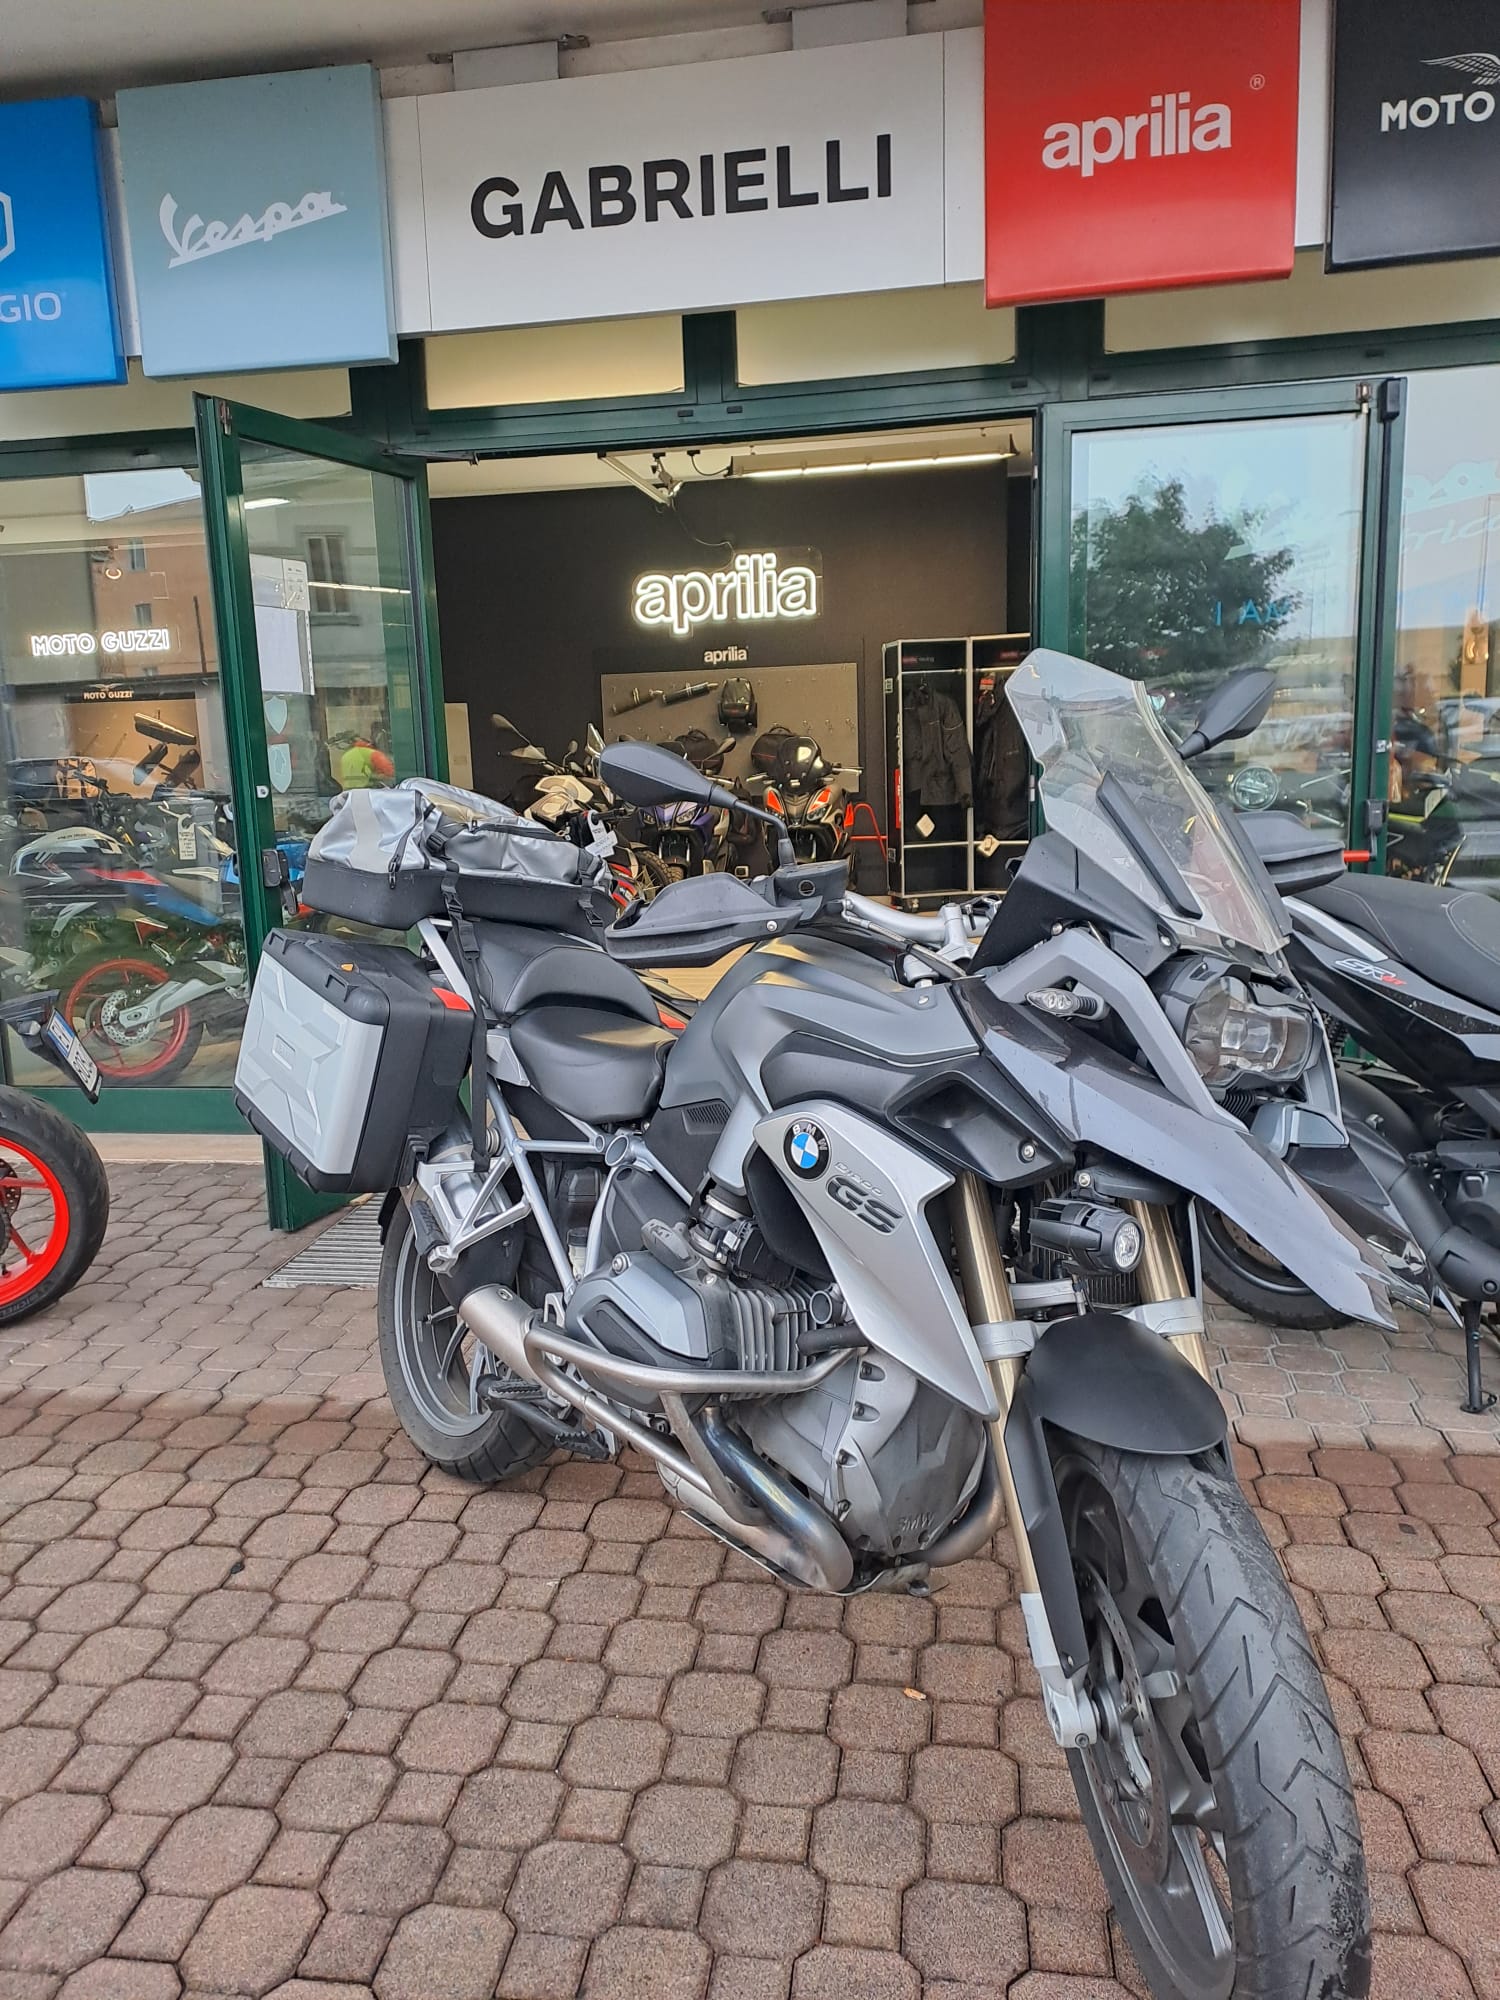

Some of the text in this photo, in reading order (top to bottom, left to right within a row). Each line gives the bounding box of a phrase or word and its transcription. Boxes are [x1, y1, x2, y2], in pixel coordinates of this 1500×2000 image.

[1041, 91, 1232, 177] aprilia
[1381, 91, 1496, 132] MOTO
[470, 133, 892, 239] GABRIELLI
[159, 190, 348, 269] Vespa
[635, 553, 817, 634] aprilia
[31, 628, 170, 657] MOTO GUZZI
[703, 645, 748, 665] aprilia
[83, 690, 134, 700] MOTO GUZZI
[792, 1123, 828, 1151] BMW
[827, 1177, 903, 1234] GS
